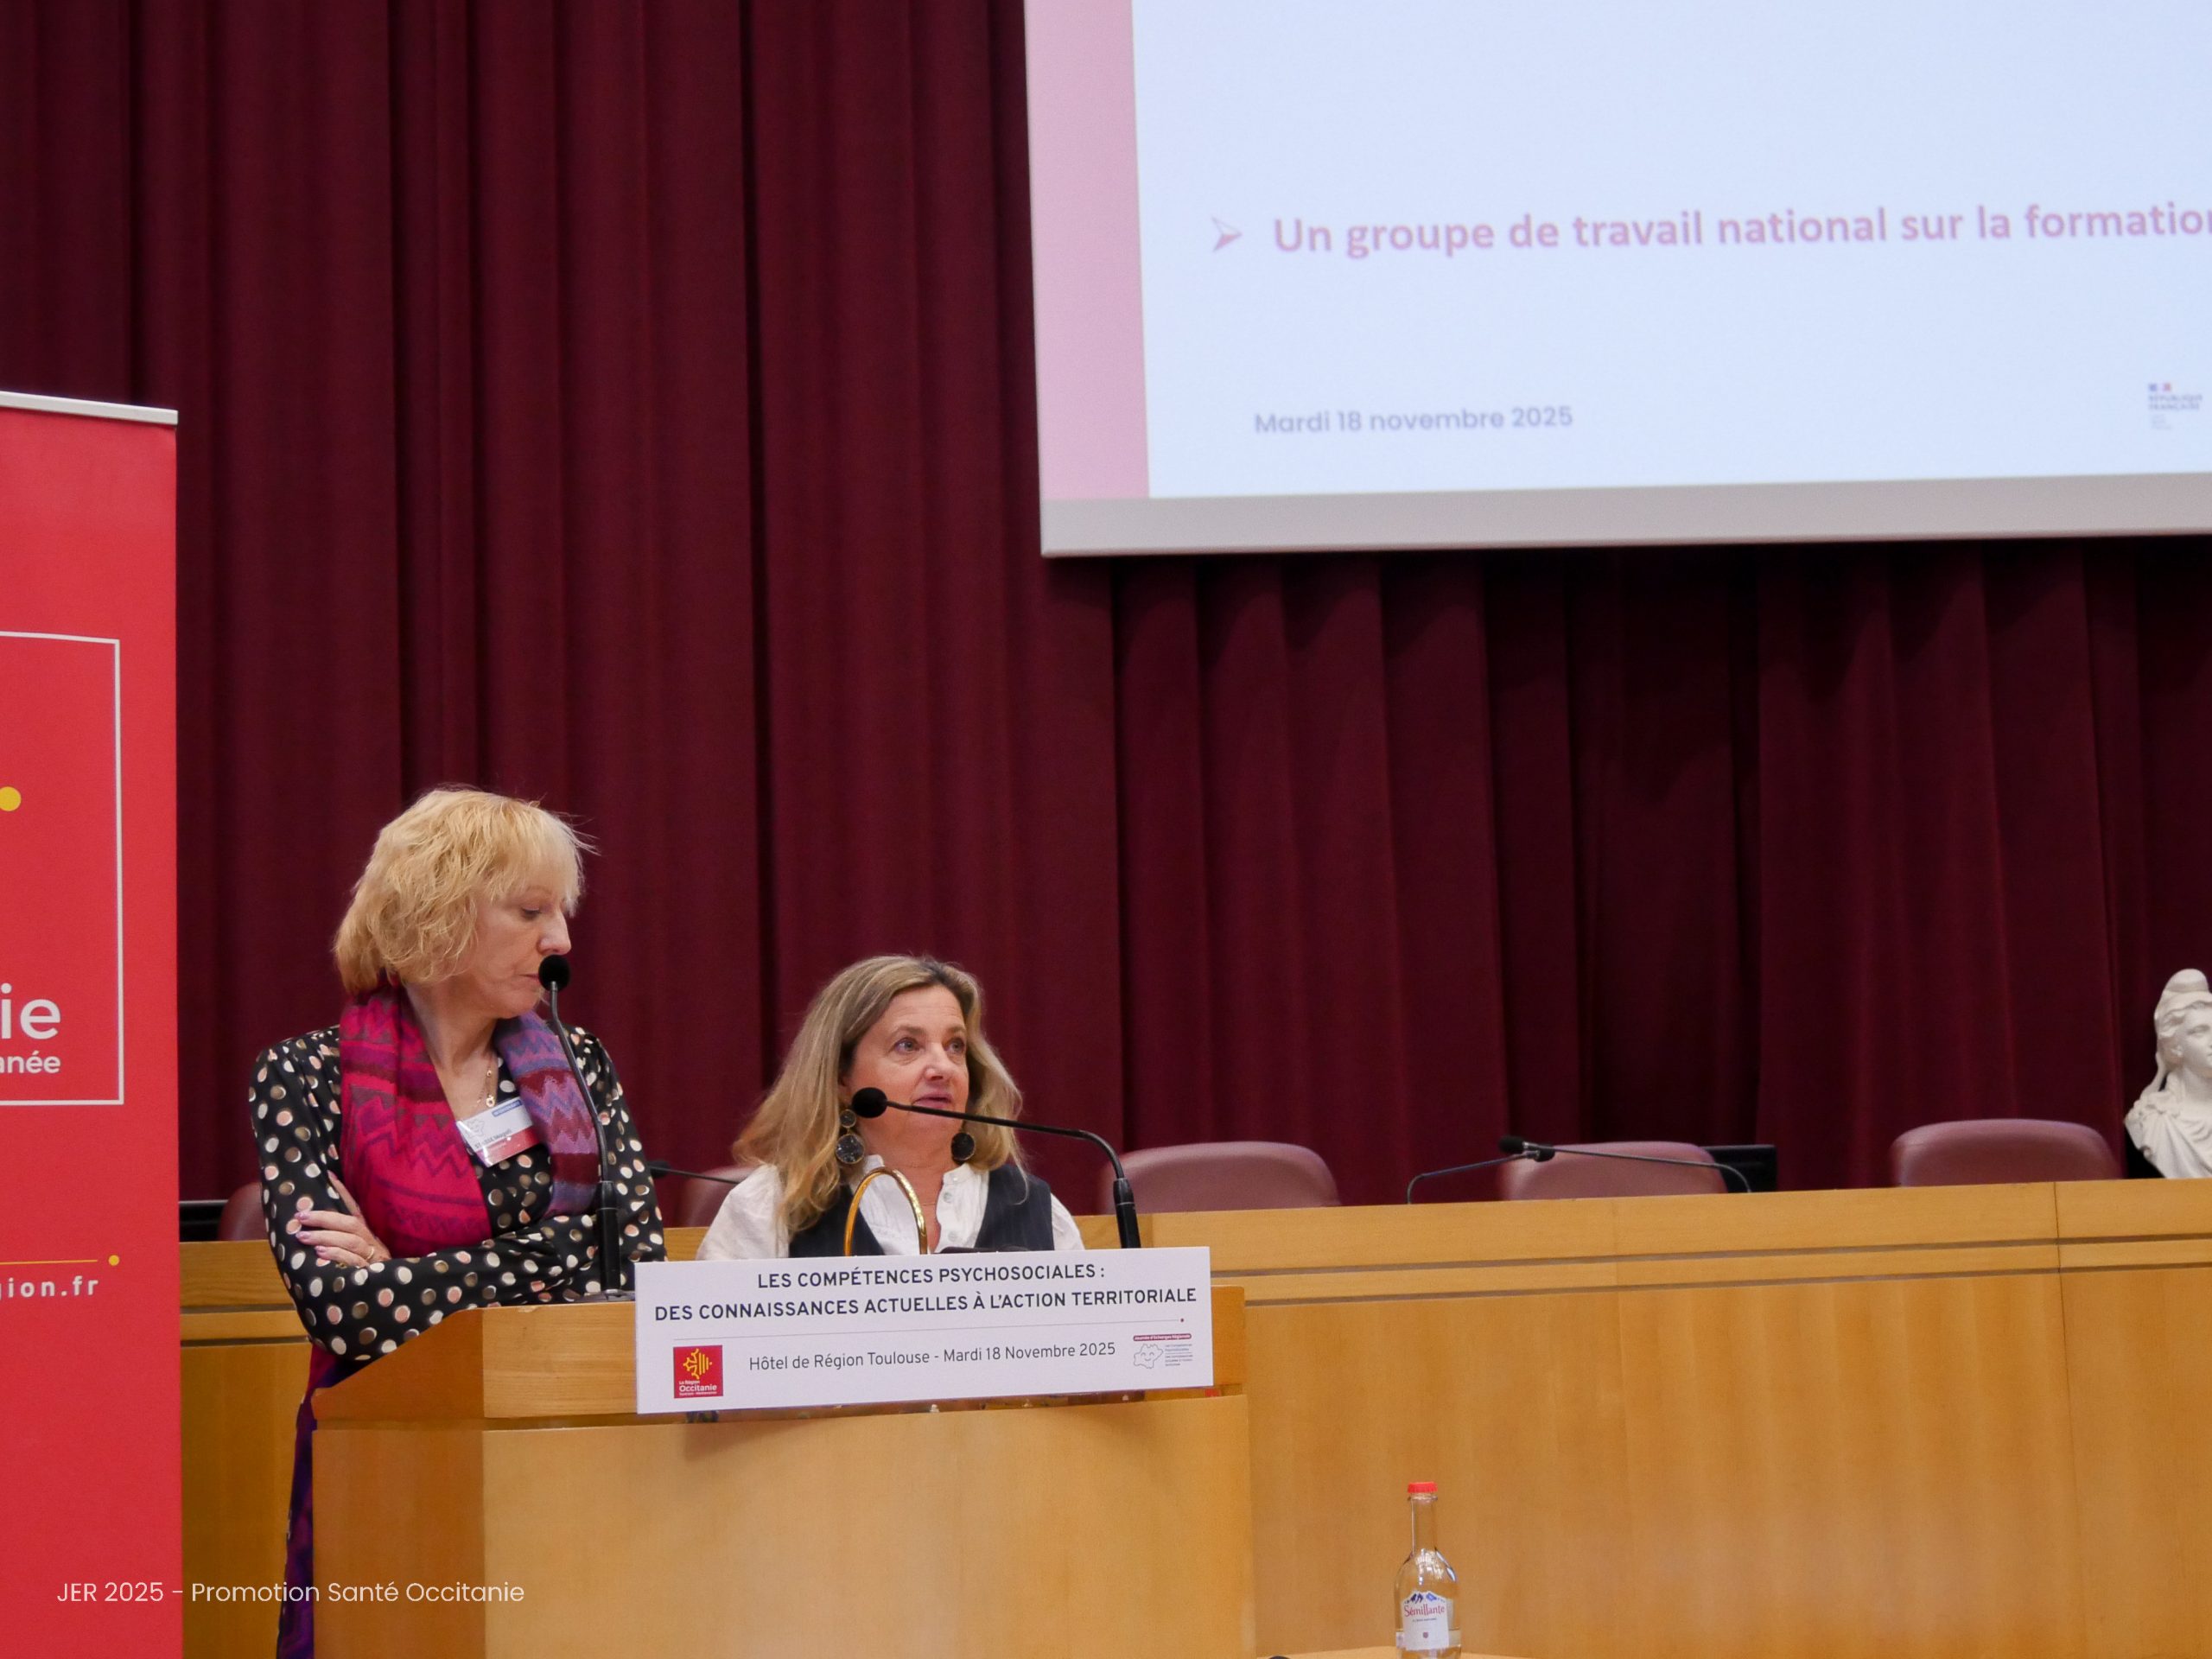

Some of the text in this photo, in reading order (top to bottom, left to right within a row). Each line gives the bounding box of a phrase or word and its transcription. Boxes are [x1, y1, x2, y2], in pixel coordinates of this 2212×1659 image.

[1274, 218, 1332, 253] Un
[1345, 223, 1495, 260] groupe
[1509, 213, 1559, 249] de
[1572, 209, 1703, 248] travail
[1717, 206, 1887, 245] national
[1901, 214, 1964, 242] sur
[1977, 204, 2012, 239] la
[1254, 405, 1573, 434] Mardi 18 novembre 2025
[0, 1275, 99, 1300] ion.fr
[758, 1273, 792, 1289] LES
[798, 1267, 934, 1287] COMPÉTENCES
[938, 1264, 1096, 1283] PSYCHOSOCIALES
[655, 1305, 693, 1321] DES
[698, 1300, 859, 1320] CONNAISSANCES
[864, 1296, 969, 1314] ACTUELLES
[973, 1290, 985, 1310] À
[1071, 1287, 1197, 1306] TERRITORIALE
[749, 1354, 788, 1371] Hôtel
[792, 1356, 810, 1370] de
[814, 1352, 864, 1370] Région
[867, 1351, 931, 1366] Toulouse
[944, 1347, 982, 1363] Mardi
[987, 1347, 1001, 1361] 18
[1005, 1344, 1076, 1360] Novembre
[1079, 1341, 1116, 1357] 2025
